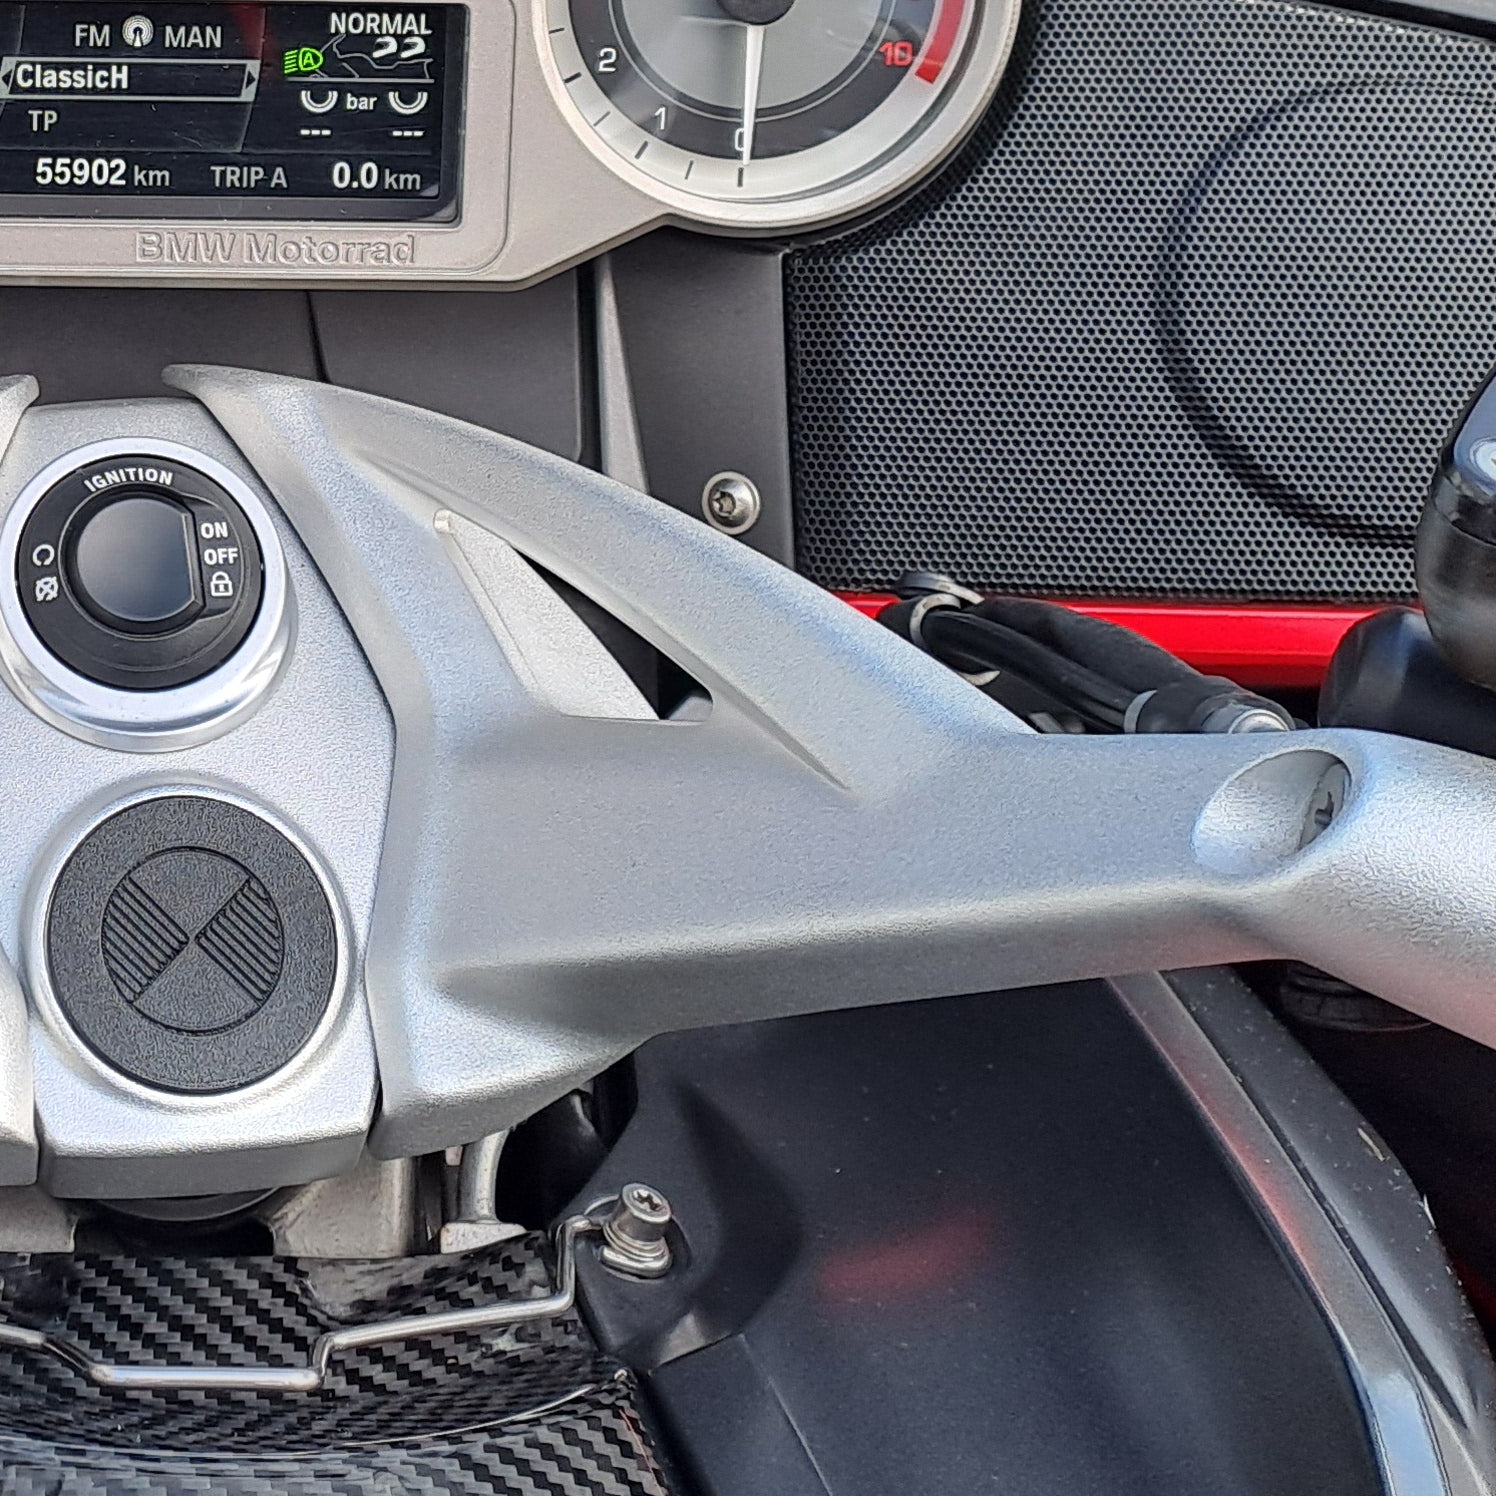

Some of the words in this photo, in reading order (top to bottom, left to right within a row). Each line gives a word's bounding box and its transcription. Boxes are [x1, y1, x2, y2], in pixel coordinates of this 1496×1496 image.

[330, 12, 432, 34] NORMAL
[75, 26, 110, 47] FM
[165, 26, 221, 47] MAN
[599, 48, 617, 72] 2
[880, 41, 913, 66] 10
[16, 65, 128, 89] ClassicH
[346, 93, 377, 110] bar
[29, 111, 58, 131] TP
[654, 107, 667, 129] 1
[35, 158, 126, 186] 55902
[133, 165, 170, 186] km
[211, 166, 263, 188] TRIP
[269, 167, 287, 188] A
[333, 162, 378, 188] 0.0
[384, 169, 421, 190] km
[135, 233, 236, 262] BMW
[243, 233, 415, 263] Motorrad
[84, 468, 173, 492] IGNITION
[201, 523, 228, 538] ON
[205, 549, 238, 564] OFF
